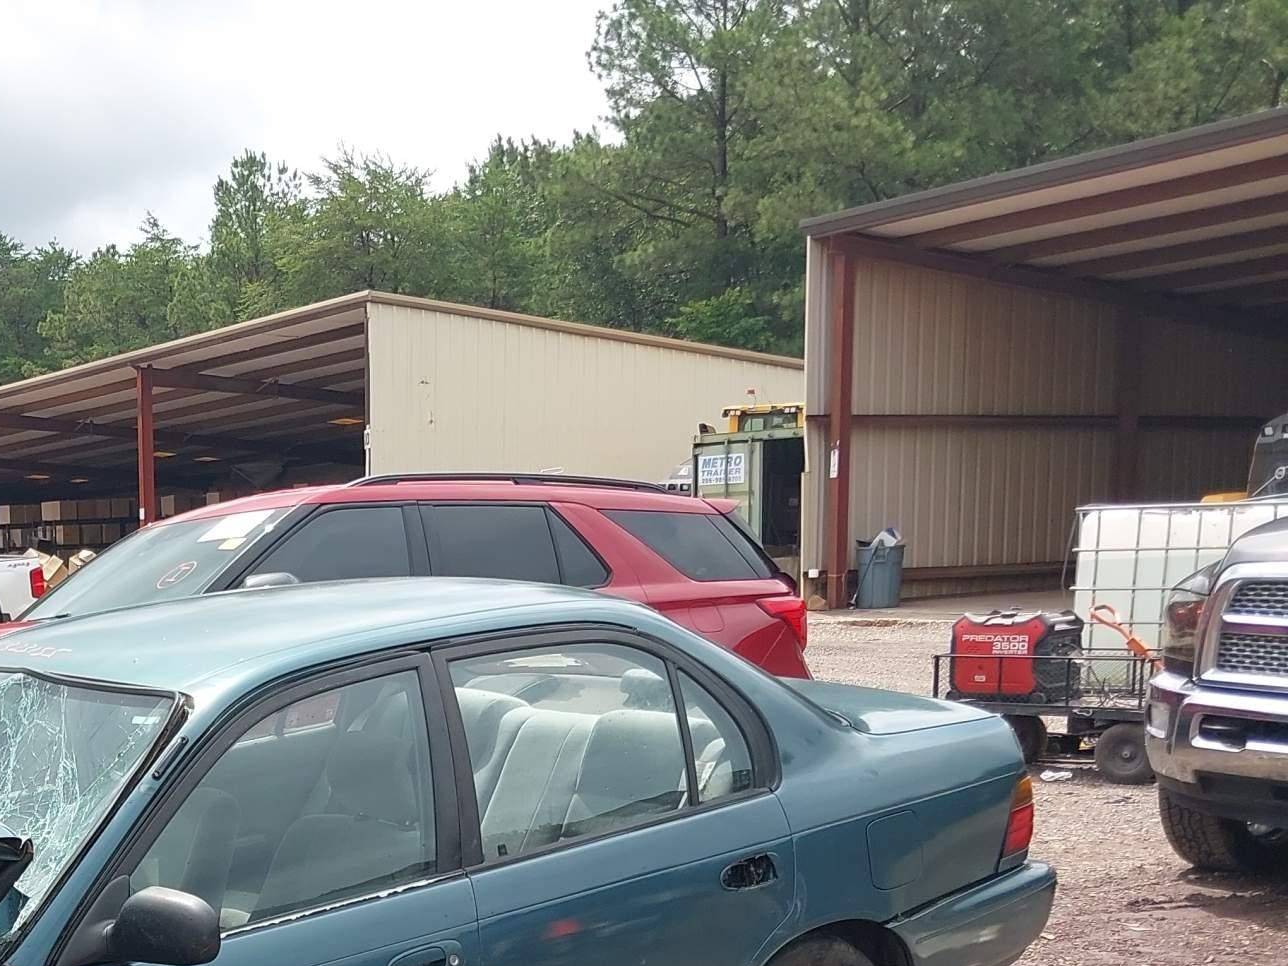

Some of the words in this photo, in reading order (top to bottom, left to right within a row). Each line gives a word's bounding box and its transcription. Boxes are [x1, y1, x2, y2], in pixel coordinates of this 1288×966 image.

[702, 456, 742, 469] METRO
[702, 468, 741, 477] TRAIER
[962, 634, 1029, 642] PREDATOR
[992, 642, 1028, 650] 3500
